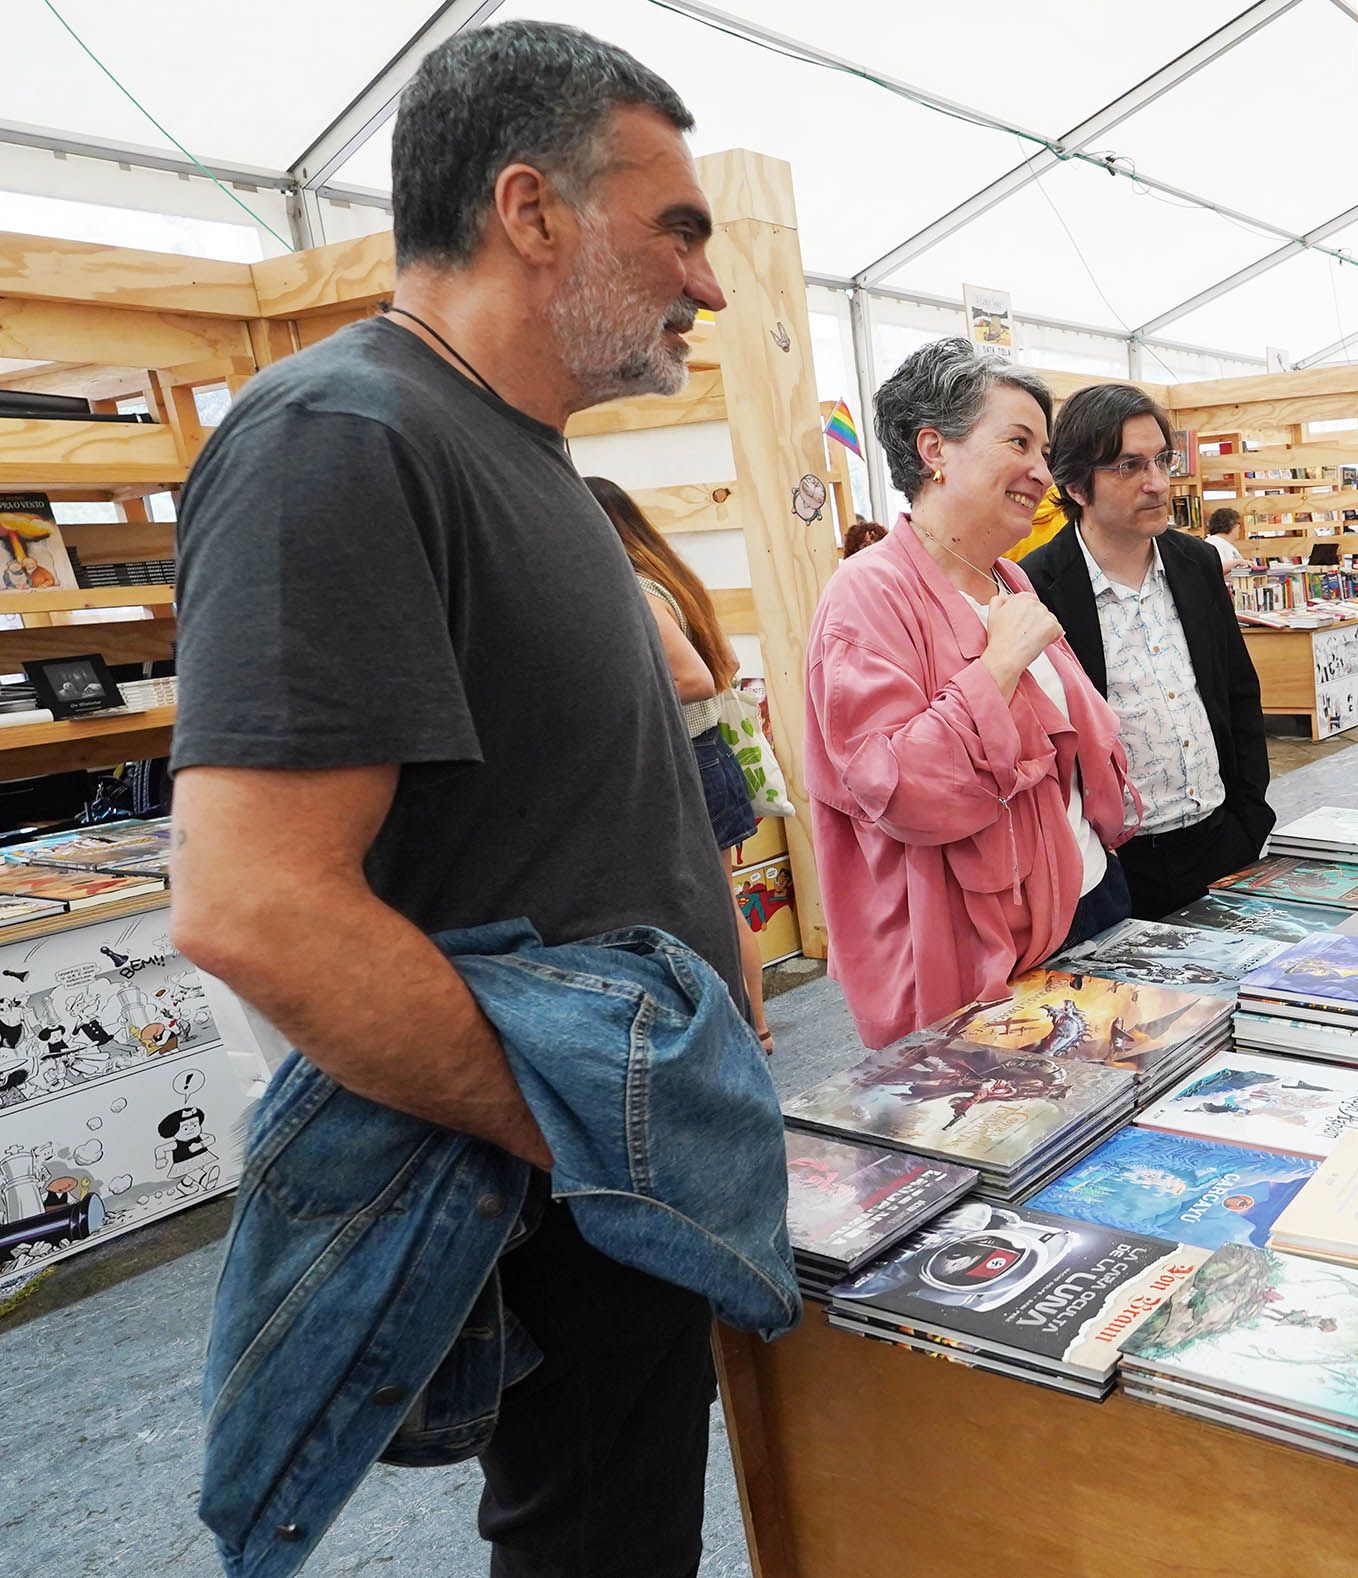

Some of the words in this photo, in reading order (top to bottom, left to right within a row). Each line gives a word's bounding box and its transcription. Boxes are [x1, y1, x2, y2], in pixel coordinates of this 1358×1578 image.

[1180, 1173, 1241, 1224] CARCAYÚ
[1090, 1258, 1116, 1273] LA
[1109, 1243, 1132, 1258] DE
[1124, 1246, 1148, 1262] LA
[1090, 1262, 1129, 1290] CARA
[1015, 1271, 1098, 1327] LUNA
[1042, 1291, 1097, 1334] OCULTA
[1094, 1295, 1162, 1343] Braun
